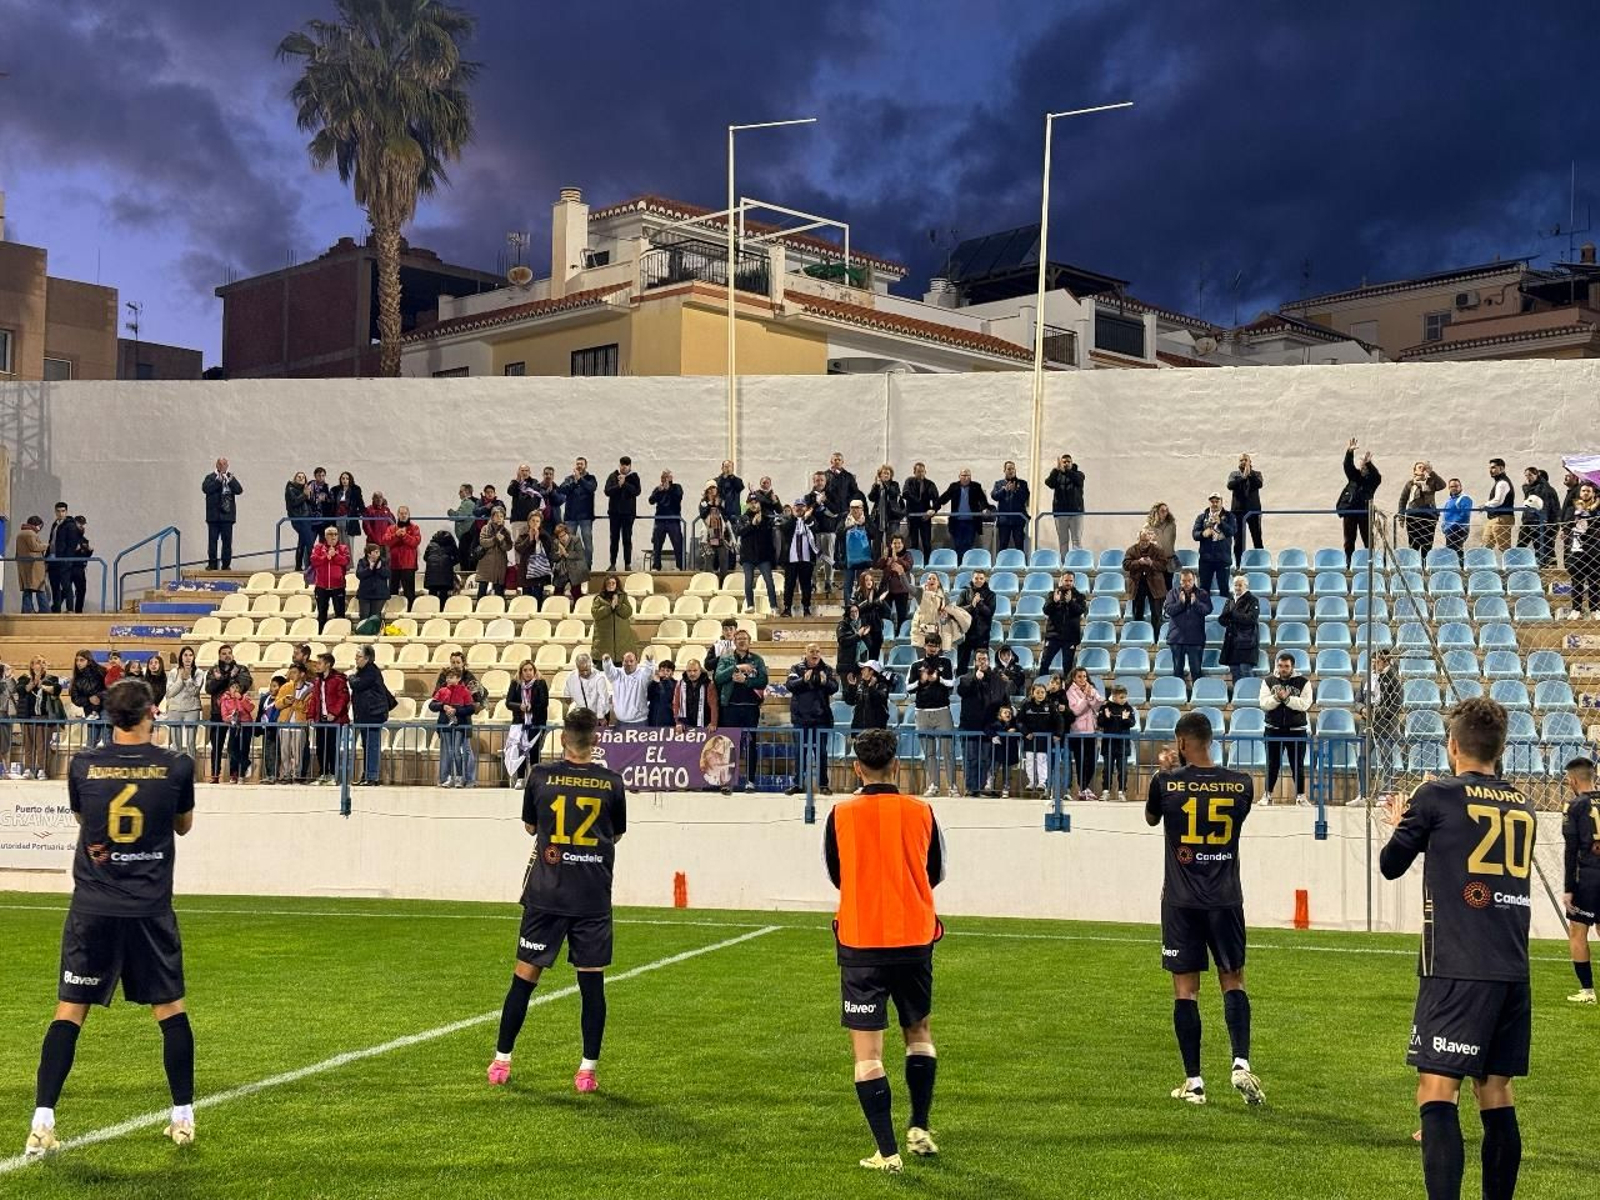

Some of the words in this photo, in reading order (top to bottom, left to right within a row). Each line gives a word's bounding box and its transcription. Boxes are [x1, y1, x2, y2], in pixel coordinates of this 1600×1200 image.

[625, 728, 664, 743] Real
[666, 728, 707, 743] Jaén
[645, 746, 667, 763] EL
[546, 775, 612, 790] J.HEREDIA
[621, 765, 689, 788] CHATO
[1166, 781, 1185, 792] DE
[1188, 781, 1245, 793] CASTRO
[1465, 785, 1526, 804] MAURO
[15, 804, 42, 813] Puerto
[45, 805, 55, 813] de
[108, 783, 144, 843] 6
[549, 795, 601, 846] 12
[1181, 797, 1234, 845] 15
[0, 842, 31, 850] utoridad
[32, 843, 65, 851] Portuaria
[1467, 804, 1534, 878] 20
[110, 852, 164, 861] Candela
[562, 852, 604, 863] Candela
[844, 1000, 875, 1013] Blaveo
[1432, 1036, 1478, 1056] Blaveo
